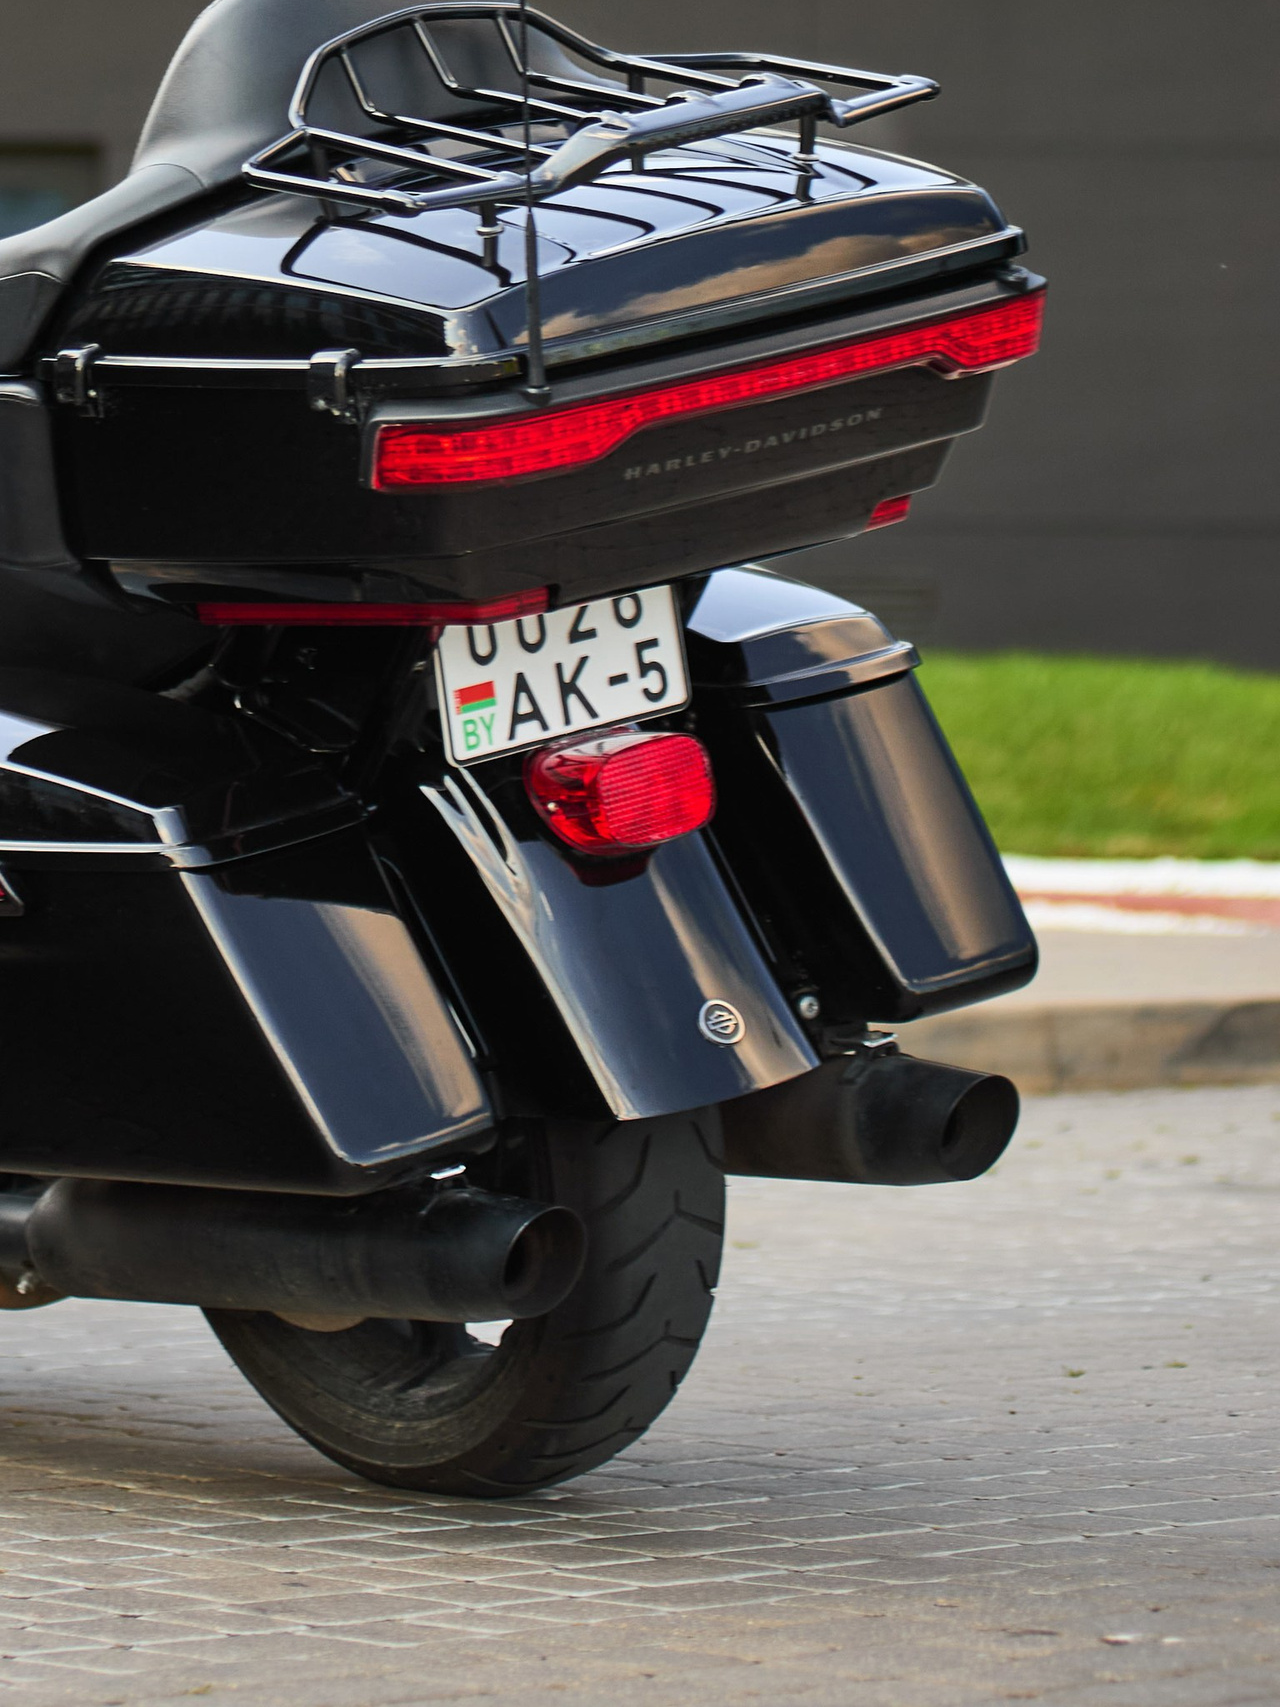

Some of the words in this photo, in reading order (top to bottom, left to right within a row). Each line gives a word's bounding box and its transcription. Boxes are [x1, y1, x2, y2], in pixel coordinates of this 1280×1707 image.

[623, 407, 883, 480] HARLEY-DAVIDSON
[508, 637, 668, 741] AK-5
[462, 713, 496, 751] BY
